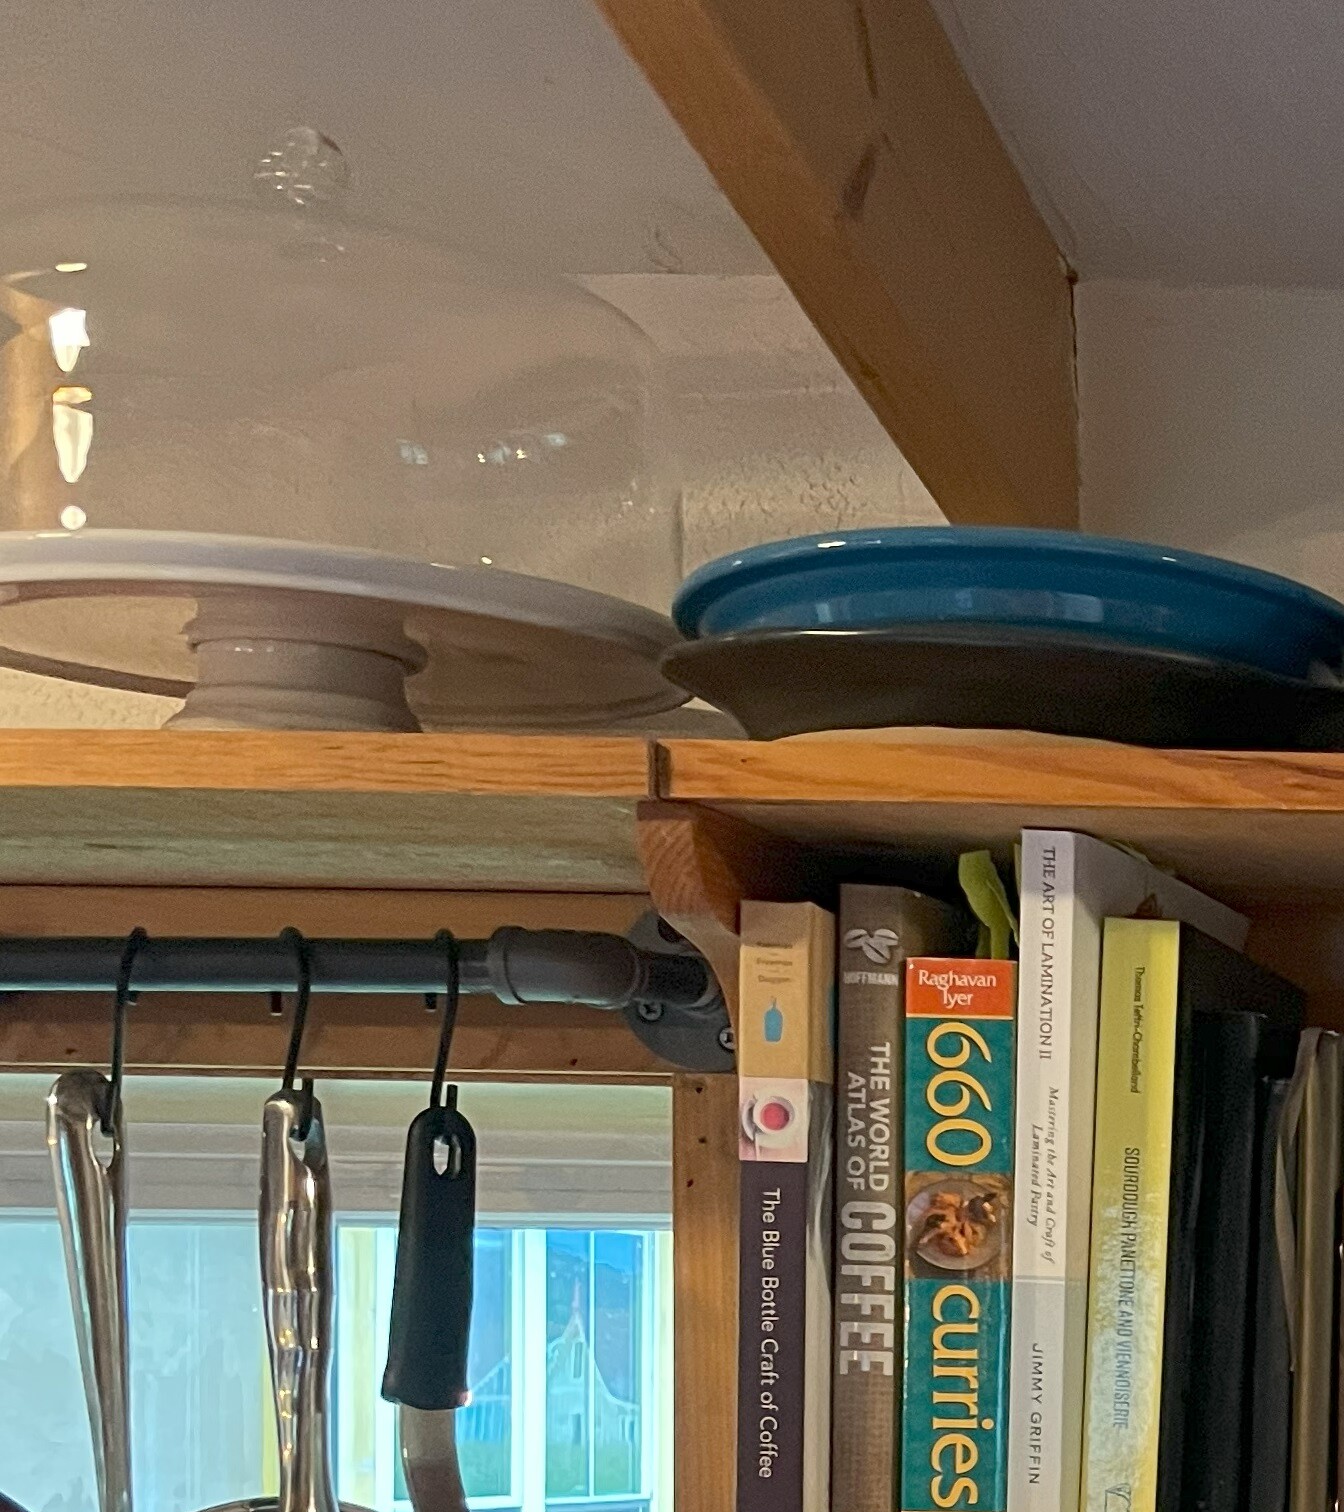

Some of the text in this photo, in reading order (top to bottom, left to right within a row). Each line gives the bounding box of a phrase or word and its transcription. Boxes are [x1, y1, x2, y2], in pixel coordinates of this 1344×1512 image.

[918, 969, 997, 990] Raghavan
[942, 989, 973, 1008] Iyer
[1039, 846, 1056, 1059] THE ART OF LAMINATION II
[1134, 967, 1145, 1002] Thomas
[846, 1071, 867, 1191] ATLAS OF
[869, 1042, 890, 1191] THE WORLD
[926, 1021, 992, 1166] 660
[1027, 1123, 1043, 1226] Laminated Pastry
[1041, 1086, 1058, 1264] Mastering the Art and Craft of
[758, 1187, 781, 1478] The Blue Bottle Craft of Coffee
[839, 1201, 897, 1376] COFFEE
[1112, 1147, 1140, 1429] SOURDOUGH PANETTONE AND VIENNOISERIE
[930, 1284, 994, 1508] curries
[1028, 1343, 1043, 1484] JIMMY GRIFFIN
